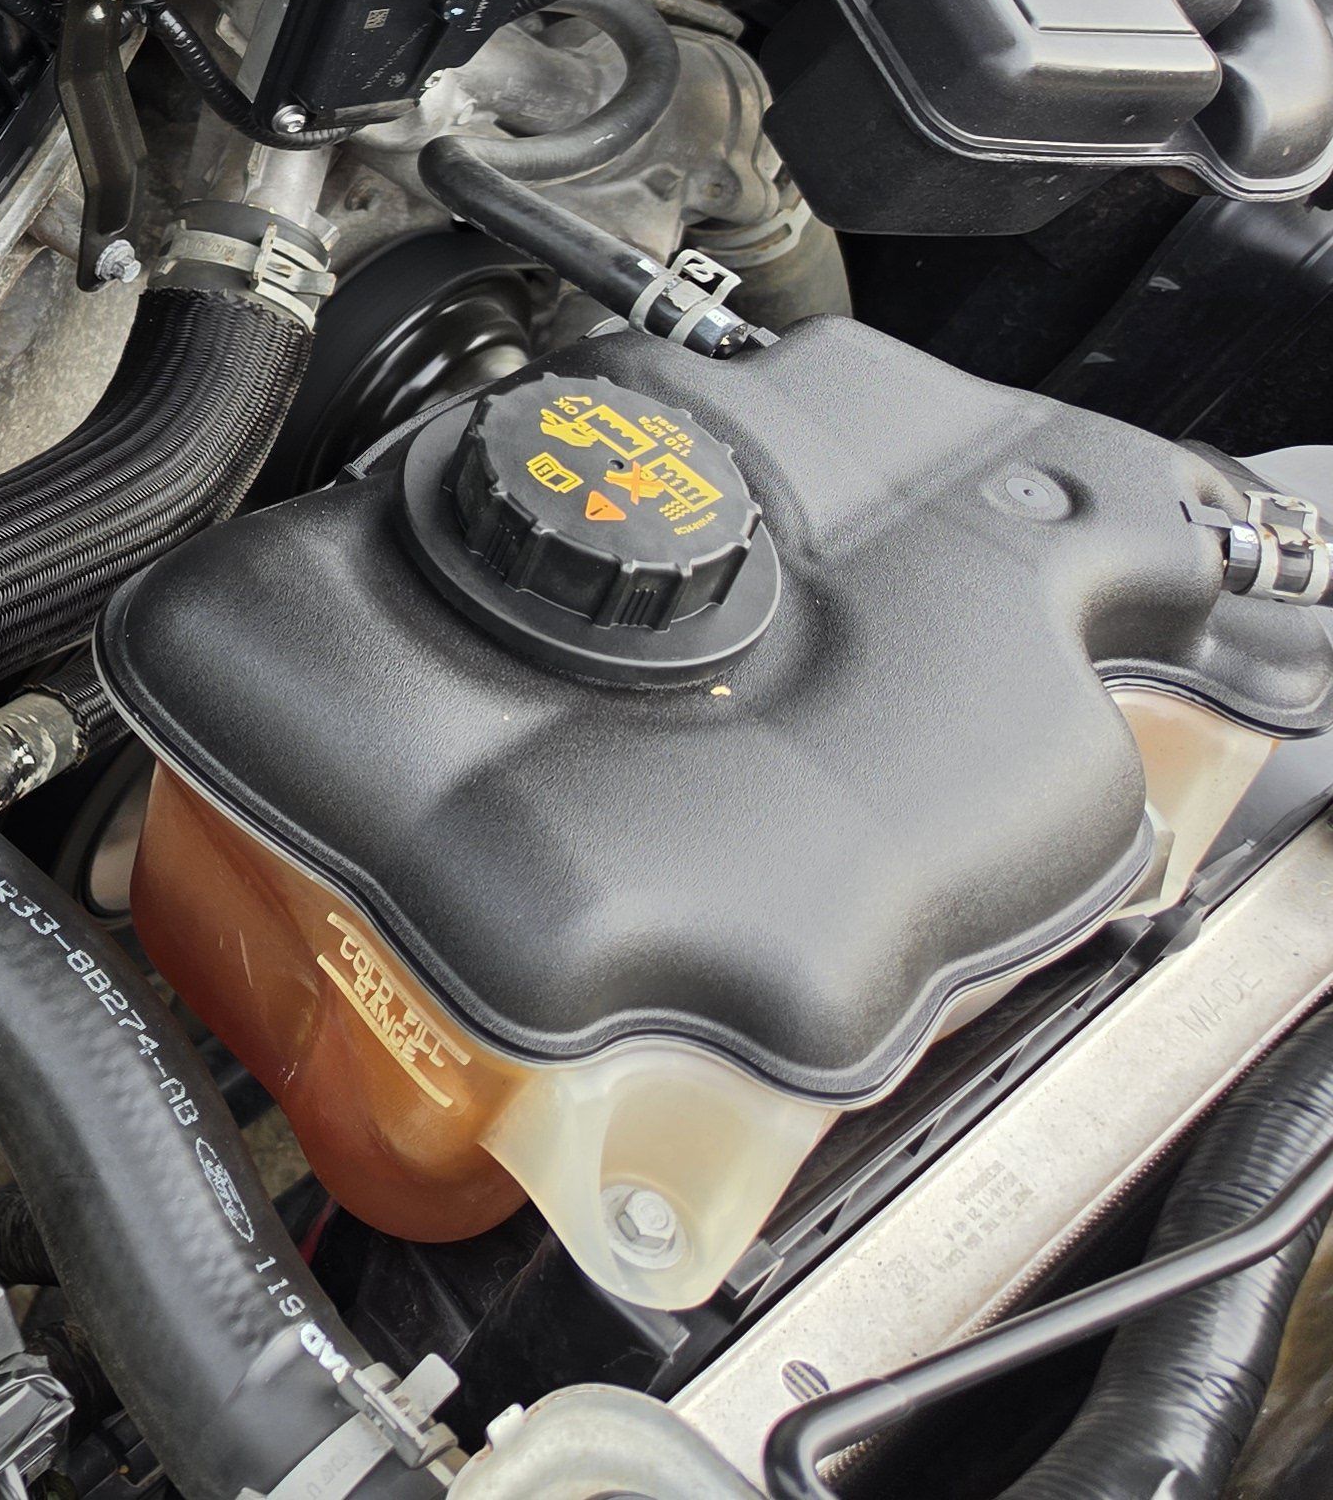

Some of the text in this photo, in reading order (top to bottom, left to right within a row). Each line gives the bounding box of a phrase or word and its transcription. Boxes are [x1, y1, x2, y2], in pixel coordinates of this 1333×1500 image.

[552, 396, 580, 417] OK
[338, 935, 446, 1069] COLD FILL
[353, 973, 419, 1065] RANGE
